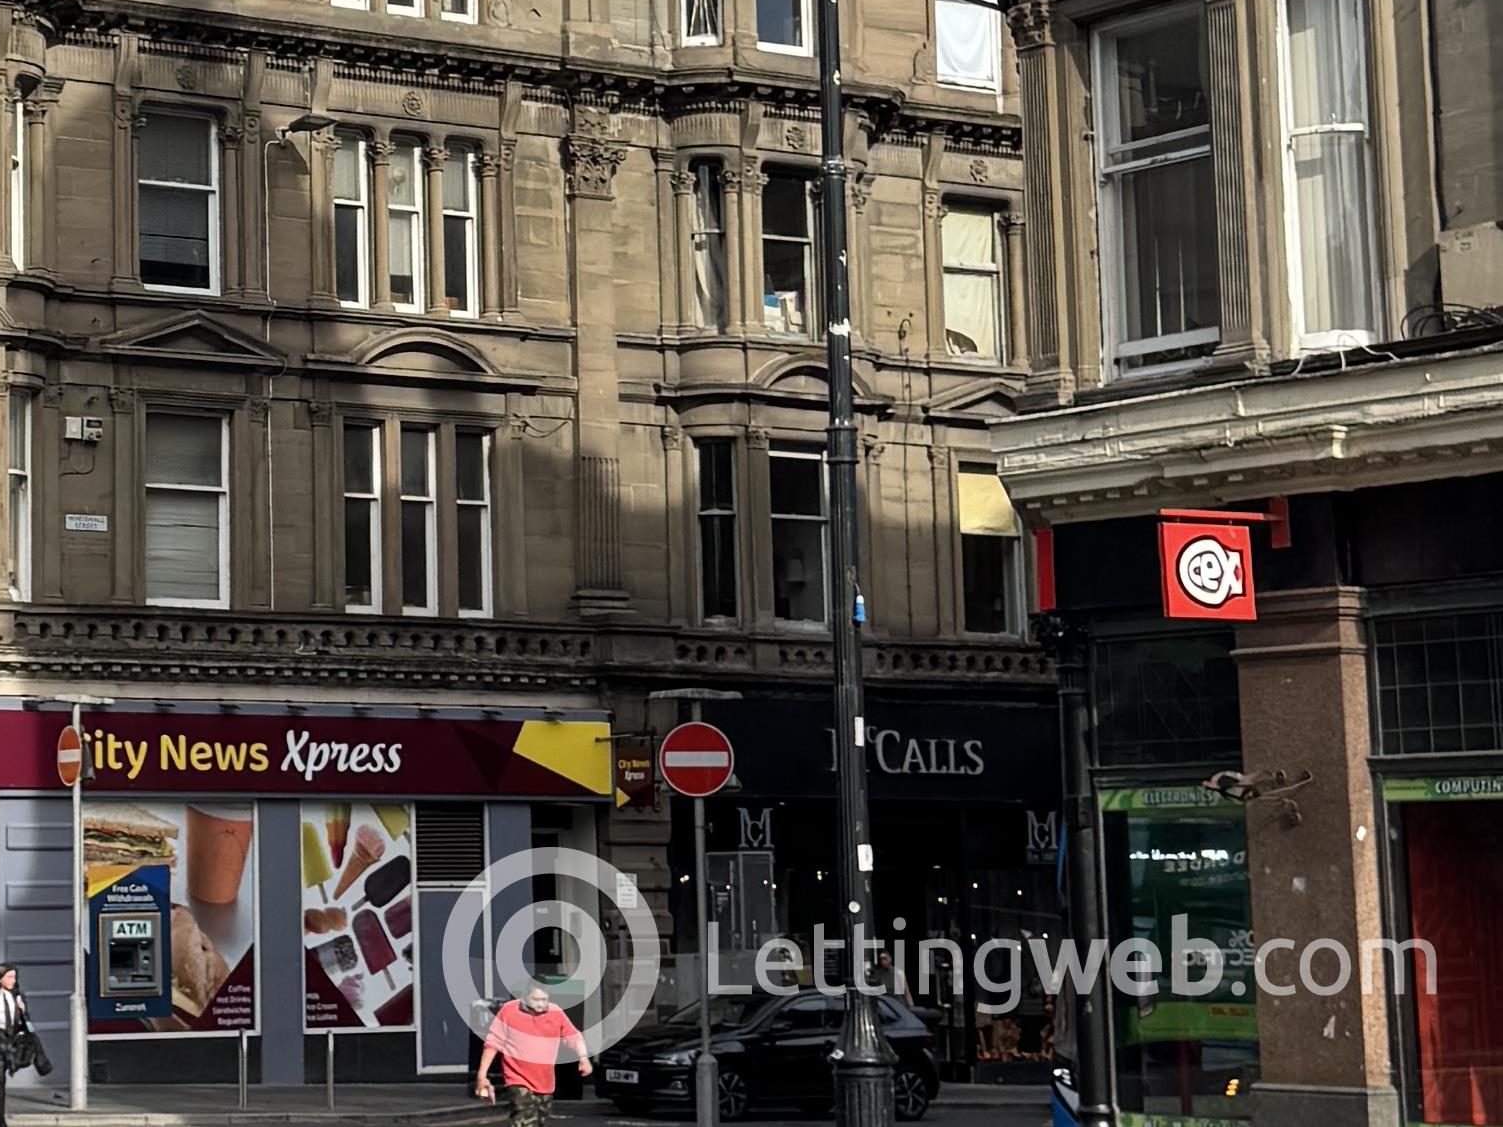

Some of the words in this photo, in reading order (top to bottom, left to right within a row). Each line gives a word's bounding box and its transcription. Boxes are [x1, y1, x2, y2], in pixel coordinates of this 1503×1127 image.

[84, 729, 148, 779] ity
[160, 733, 269, 772] News
[280, 729, 403, 781] Xpress
[1144, 789, 1213, 804] ELECTRONICS
[117, 923, 147, 934] ATM
